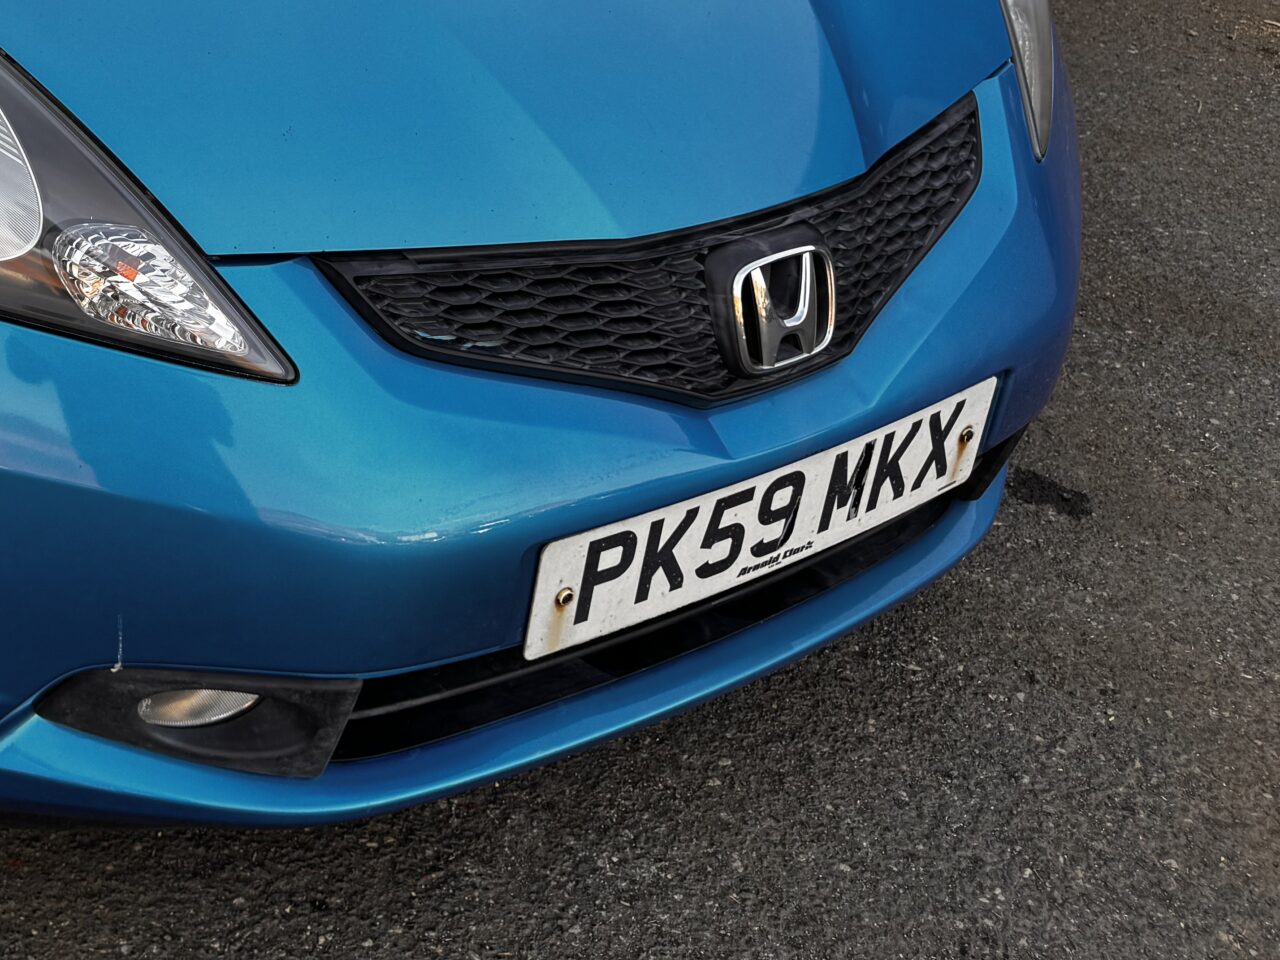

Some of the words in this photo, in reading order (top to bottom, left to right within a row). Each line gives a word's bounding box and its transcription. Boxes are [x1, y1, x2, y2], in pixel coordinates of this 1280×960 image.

[573, 470, 806, 625] PK59
[817, 399, 967, 535] MKX
[736, 553, 781, 578] Arnold
